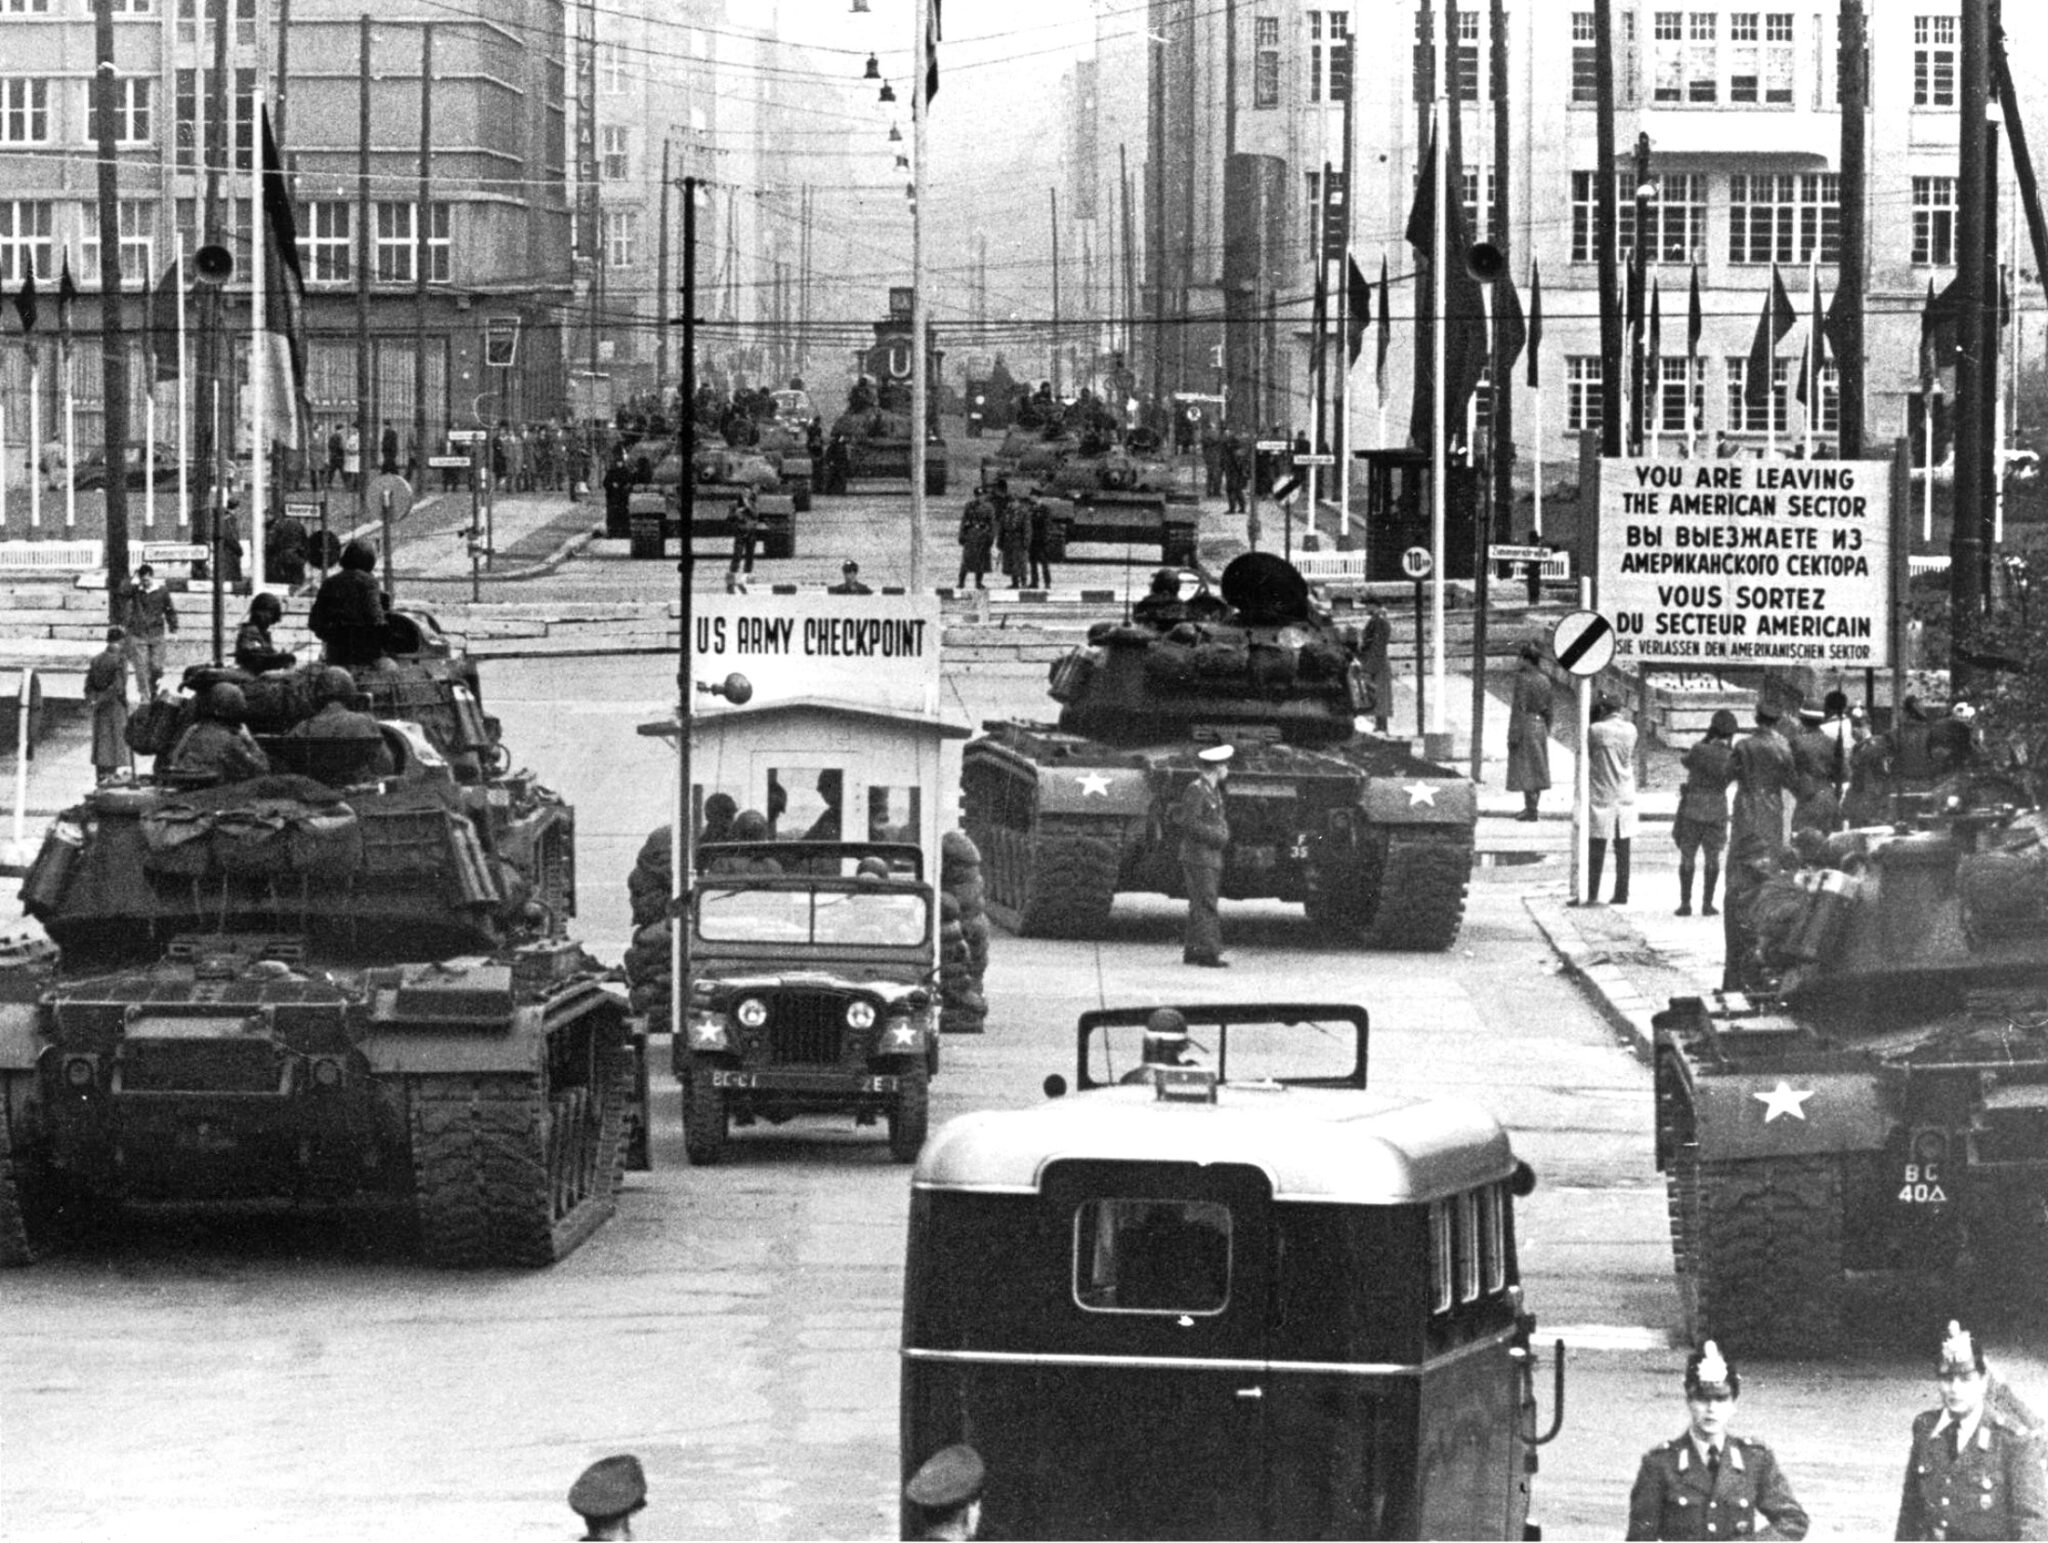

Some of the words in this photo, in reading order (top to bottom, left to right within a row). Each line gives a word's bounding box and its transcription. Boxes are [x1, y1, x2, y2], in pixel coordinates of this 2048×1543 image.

[890, 348, 911, 378] U
[1635, 466, 1682, 488] YOU
[1695, 467, 1742, 489] ARE
[1757, 468, 1854, 490] LEAVING
[1623, 493, 1658, 514] THE
[1669, 494, 1776, 516] AMERICAN
[1788, 496, 1866, 517] SECTOR
[1626, 526, 1662, 547] ВЫ
[1676, 526, 1818, 549] ВЫЕЗЖАЕТЕ
[1832, 528, 1862, 550] ИЗ
[1407, 551, 1422, 571] 10
[1620, 553, 1779, 576] АМЕРИКАНСКОГО
[1787, 554, 1869, 577] СЕКТОРА
[1658, 586, 1722, 607] VOUS
[1736, 587, 1825, 610] SORTEZ
[1617, 612, 1643, 633] DU
[1656, 613, 1746, 636] SECTEUR
[1757, 616, 1871, 637] AMERICAIN
[697, 617, 726, 654] US
[738, 617, 794, 654] ARMY
[804, 618, 927, 657] CHECKPOINT
[1616, 640, 1633, 655] SIE
[1638, 640, 1700, 656] VERLASSEN
[1705, 641, 1726, 657] DEN
[1731, 642, 1824, 659] AMERIKANISCHEN
[1829, 643, 1870, 659] SEKTOR
